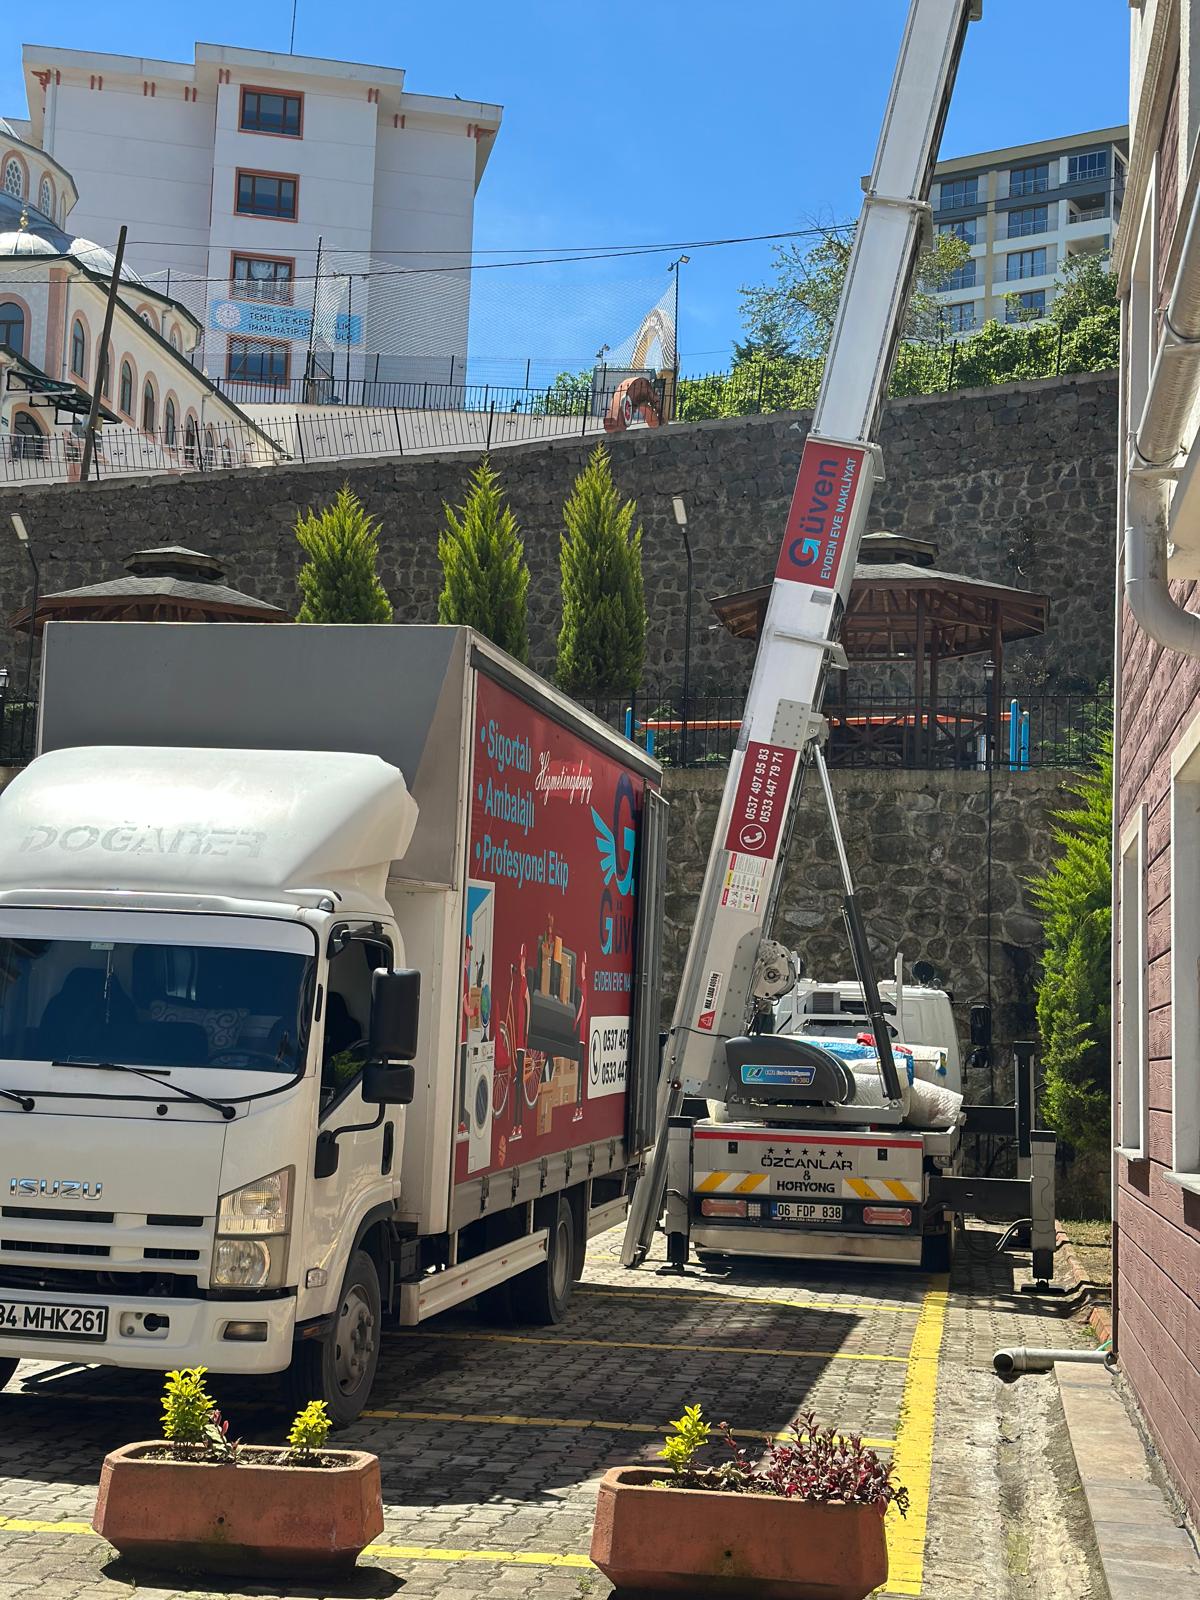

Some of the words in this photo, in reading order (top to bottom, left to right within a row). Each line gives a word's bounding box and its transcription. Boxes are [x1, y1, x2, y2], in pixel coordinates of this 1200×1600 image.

[788, 459, 839, 567] Güven
[820, 540, 838, 580] EVDEN
[830, 515, 844, 538] EVE
[487, 719, 532, 773] Sigortalı
[758, 748, 769, 761] 83
[755, 762, 767, 775] 95
[769, 764, 781, 777] 79
[750, 775, 763, 794] 497
[765, 779, 778, 797] 447
[484, 777, 535, 836] Ambalajlı
[745, 796, 758, 820] 0537
[759, 799, 773, 823] 0533
[482, 833, 546, 888] Profesyonel
[548, 850, 569, 895] Ekip
[594, 970, 612, 991] EVDEN
[613, 973, 622, 992] EVE
[603, 1029, 618, 1051] 0537
[602, 1061, 616, 1085] 0533
[761, 1154, 853, 1171] ÖZCANLAR
[803, 1170, 811, 1180] &
[10, 1178, 102, 1200] ISUZU
[778, 1204, 790, 1216] 06
[797, 1205, 815, 1217] FDP
[822, 1206, 841, 1219] 838
[23, 1306, 104, 1333] MHK261
